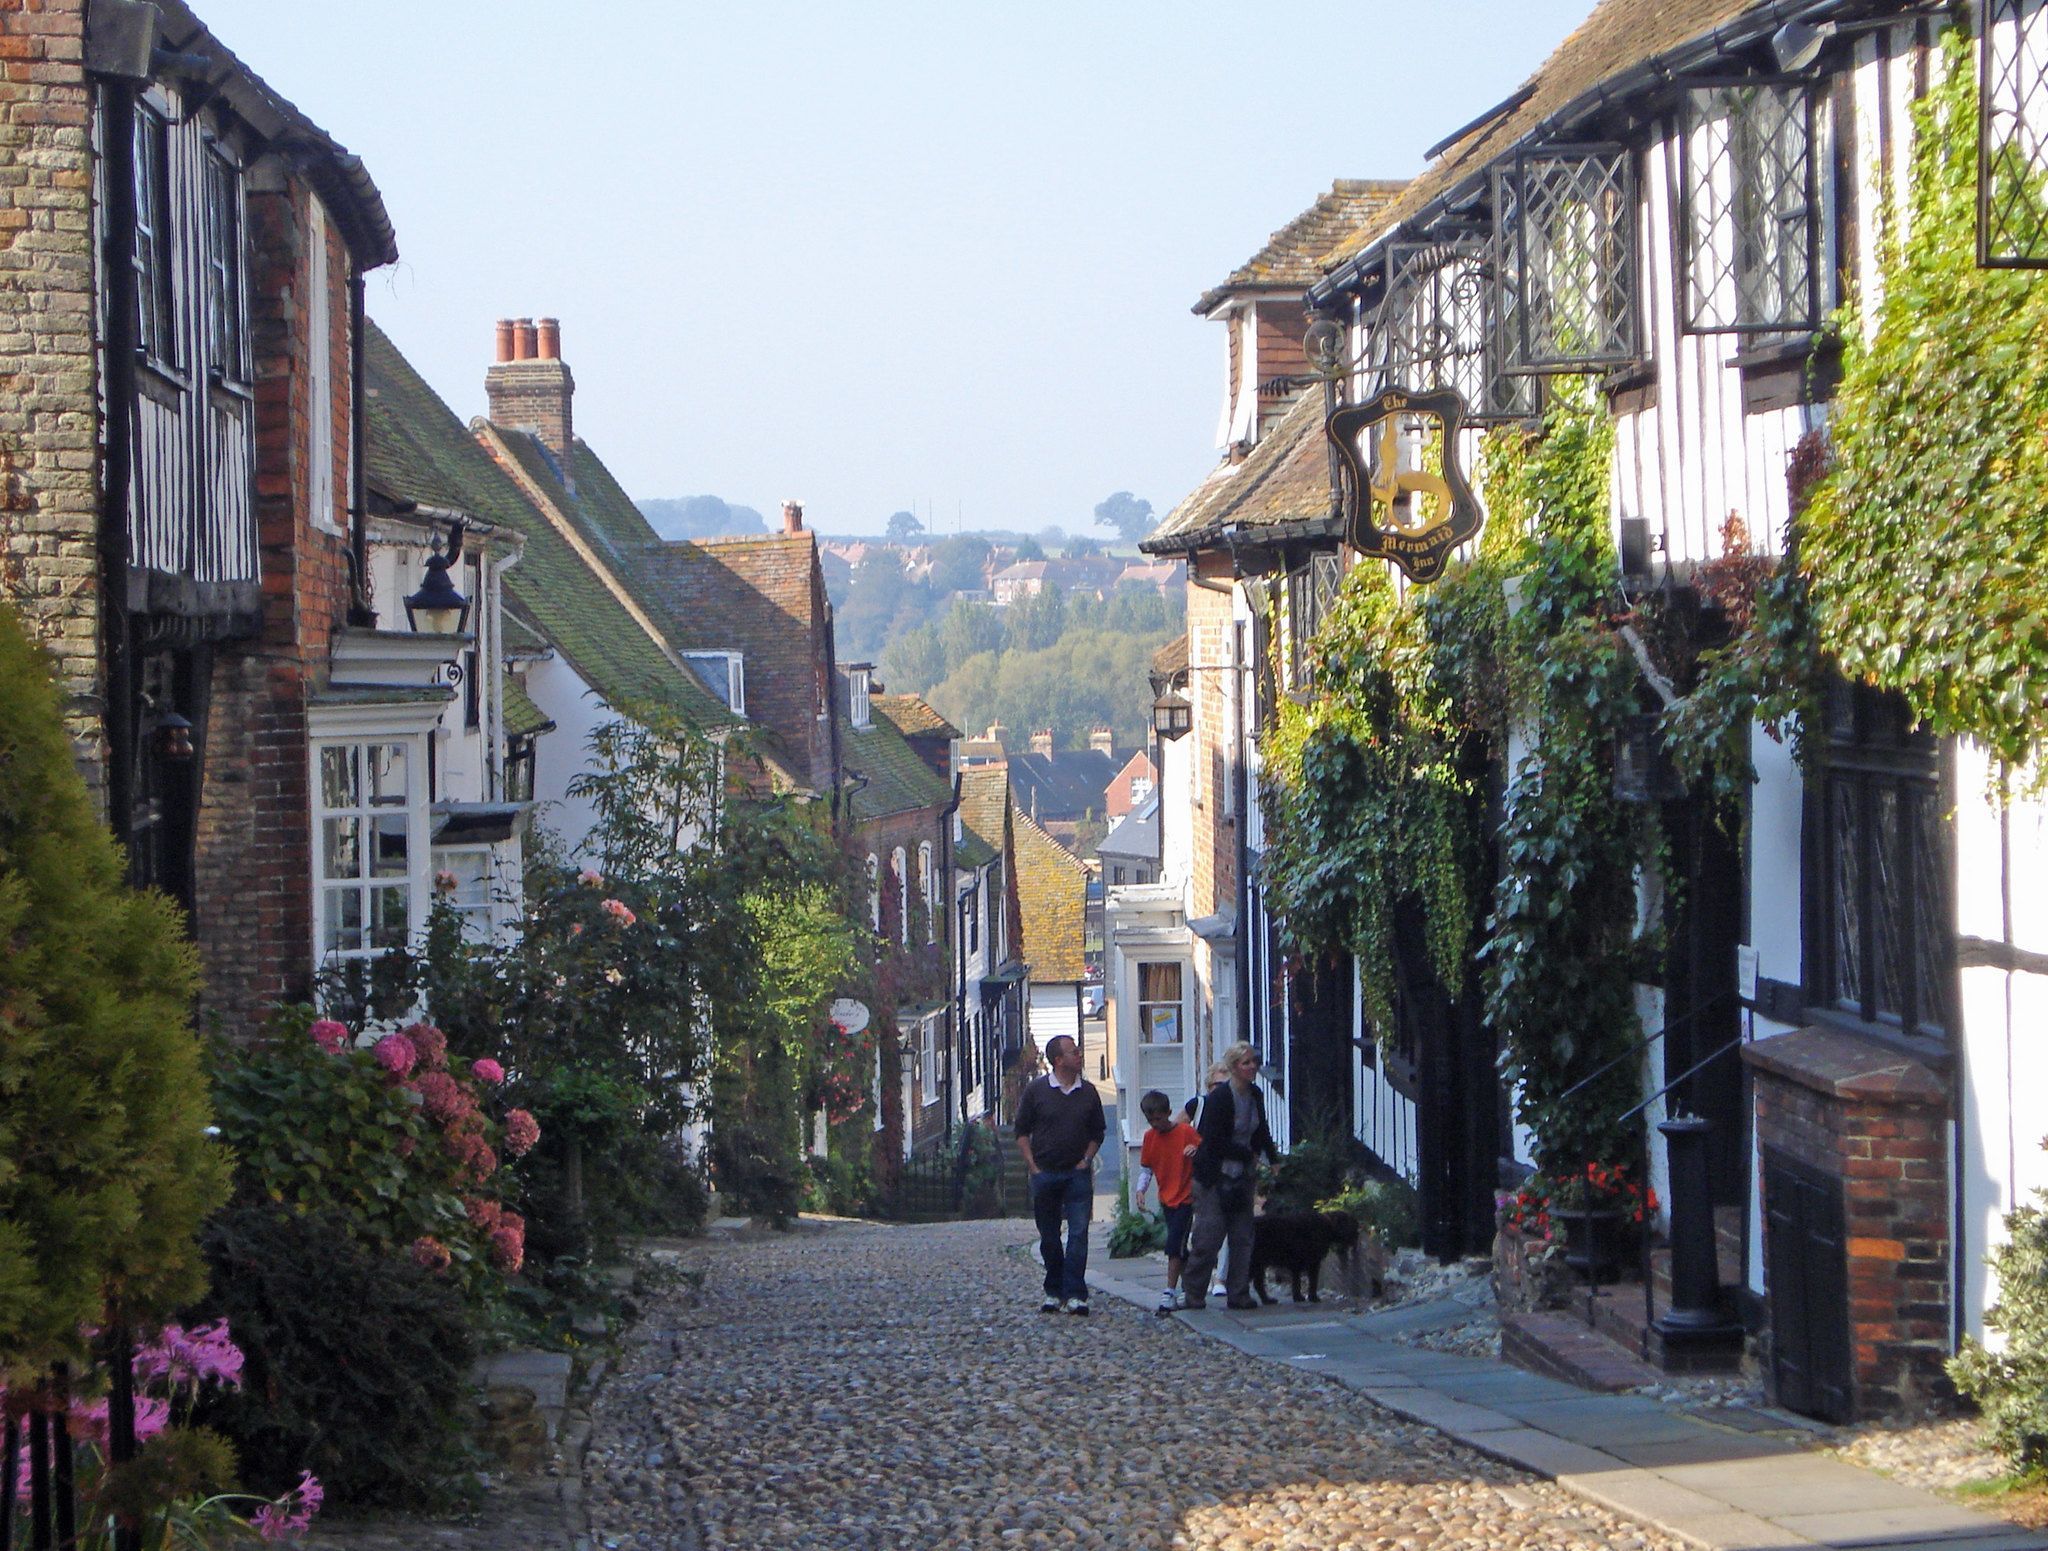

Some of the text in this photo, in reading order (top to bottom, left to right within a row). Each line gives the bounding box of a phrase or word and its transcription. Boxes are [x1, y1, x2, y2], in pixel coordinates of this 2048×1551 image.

[1383, 395, 1407, 409] The
[1382, 527, 1453, 551] Mermaid
[1412, 557, 1435, 571] Inn
